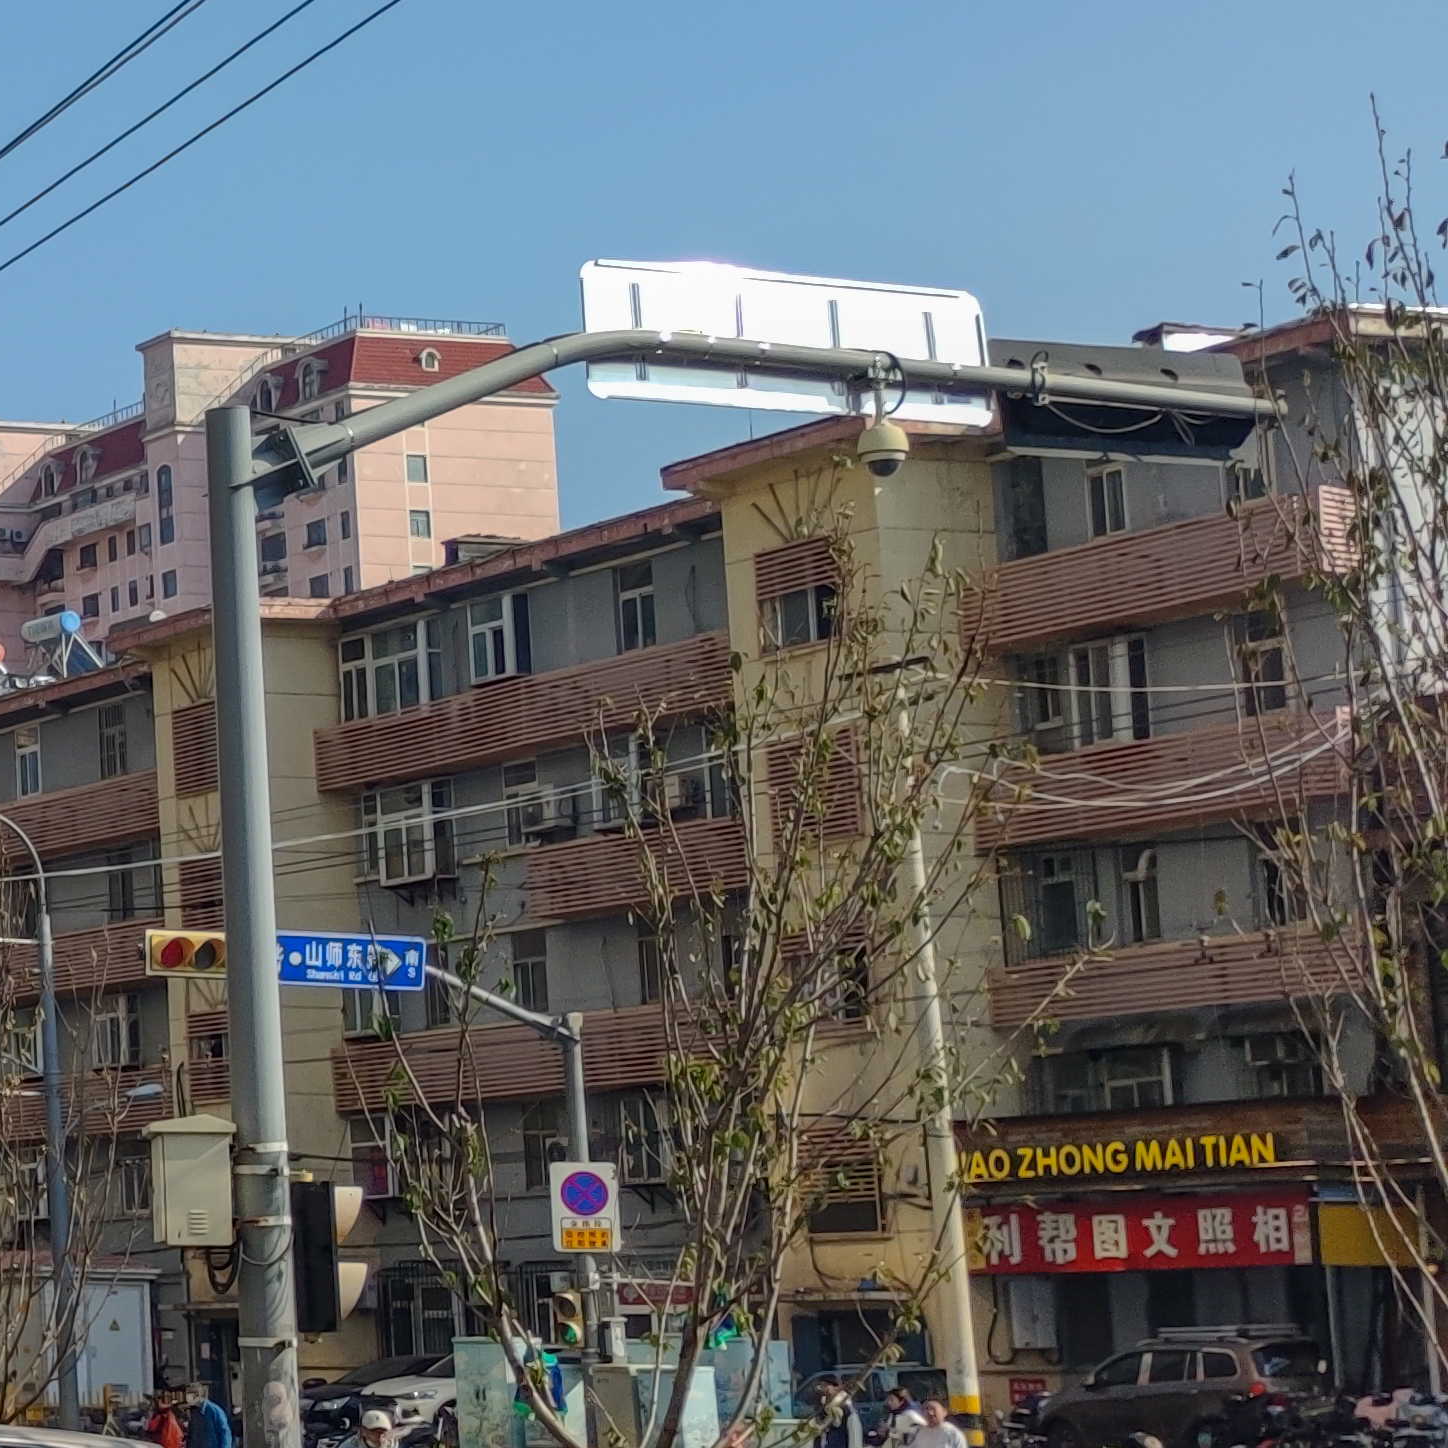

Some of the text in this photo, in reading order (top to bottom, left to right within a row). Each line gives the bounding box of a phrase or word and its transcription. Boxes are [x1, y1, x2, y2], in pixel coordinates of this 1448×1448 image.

[1016, 1140, 1129, 1179] ZHONG
[1135, 1136, 1195, 1172] MAI
[1200, 1131, 1276, 1168] TIAN
